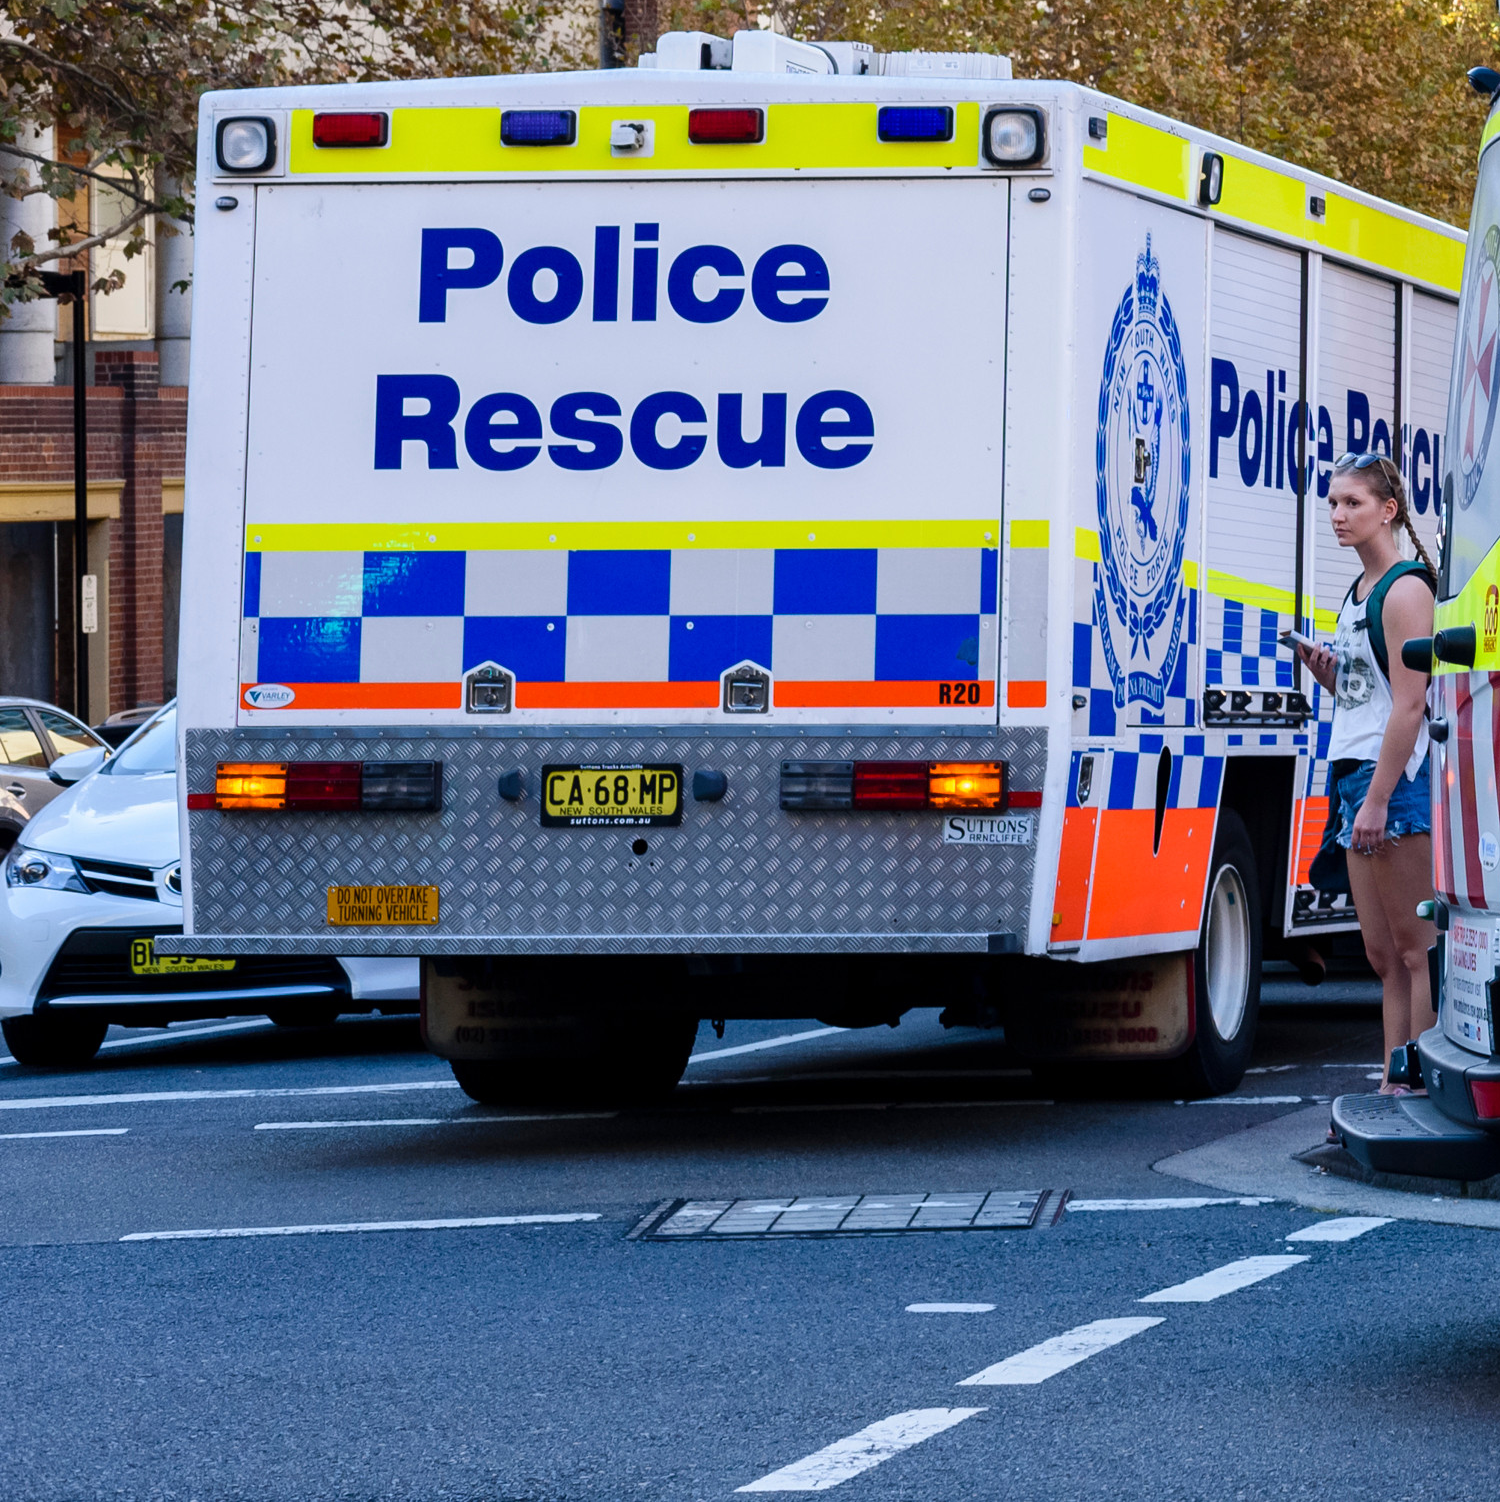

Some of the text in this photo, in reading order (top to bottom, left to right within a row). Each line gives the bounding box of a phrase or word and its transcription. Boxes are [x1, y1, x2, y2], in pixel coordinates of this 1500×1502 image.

[418, 222, 831, 325] Police
[1131, 328, 1154, 348] OUTH
[373, 372, 875, 471] Rescue
[1209, 356, 1334, 499] Police
[1116, 525, 1170, 586] POLCE FORCE
[939, 682, 980, 705] R20
[559, 806, 663, 816] NEW SOUTH WALES
[570, 816, 651, 826] suttons.com.au
[948, 817, 1028, 841] SUTTONS
[969, 833, 1023, 843] ARNCLIFFE
[337, 887, 429, 904] DO NOT OVERTAKE
[338, 904, 428, 922] TURNING VEHICLE
[197, 963, 225, 971] WALES
